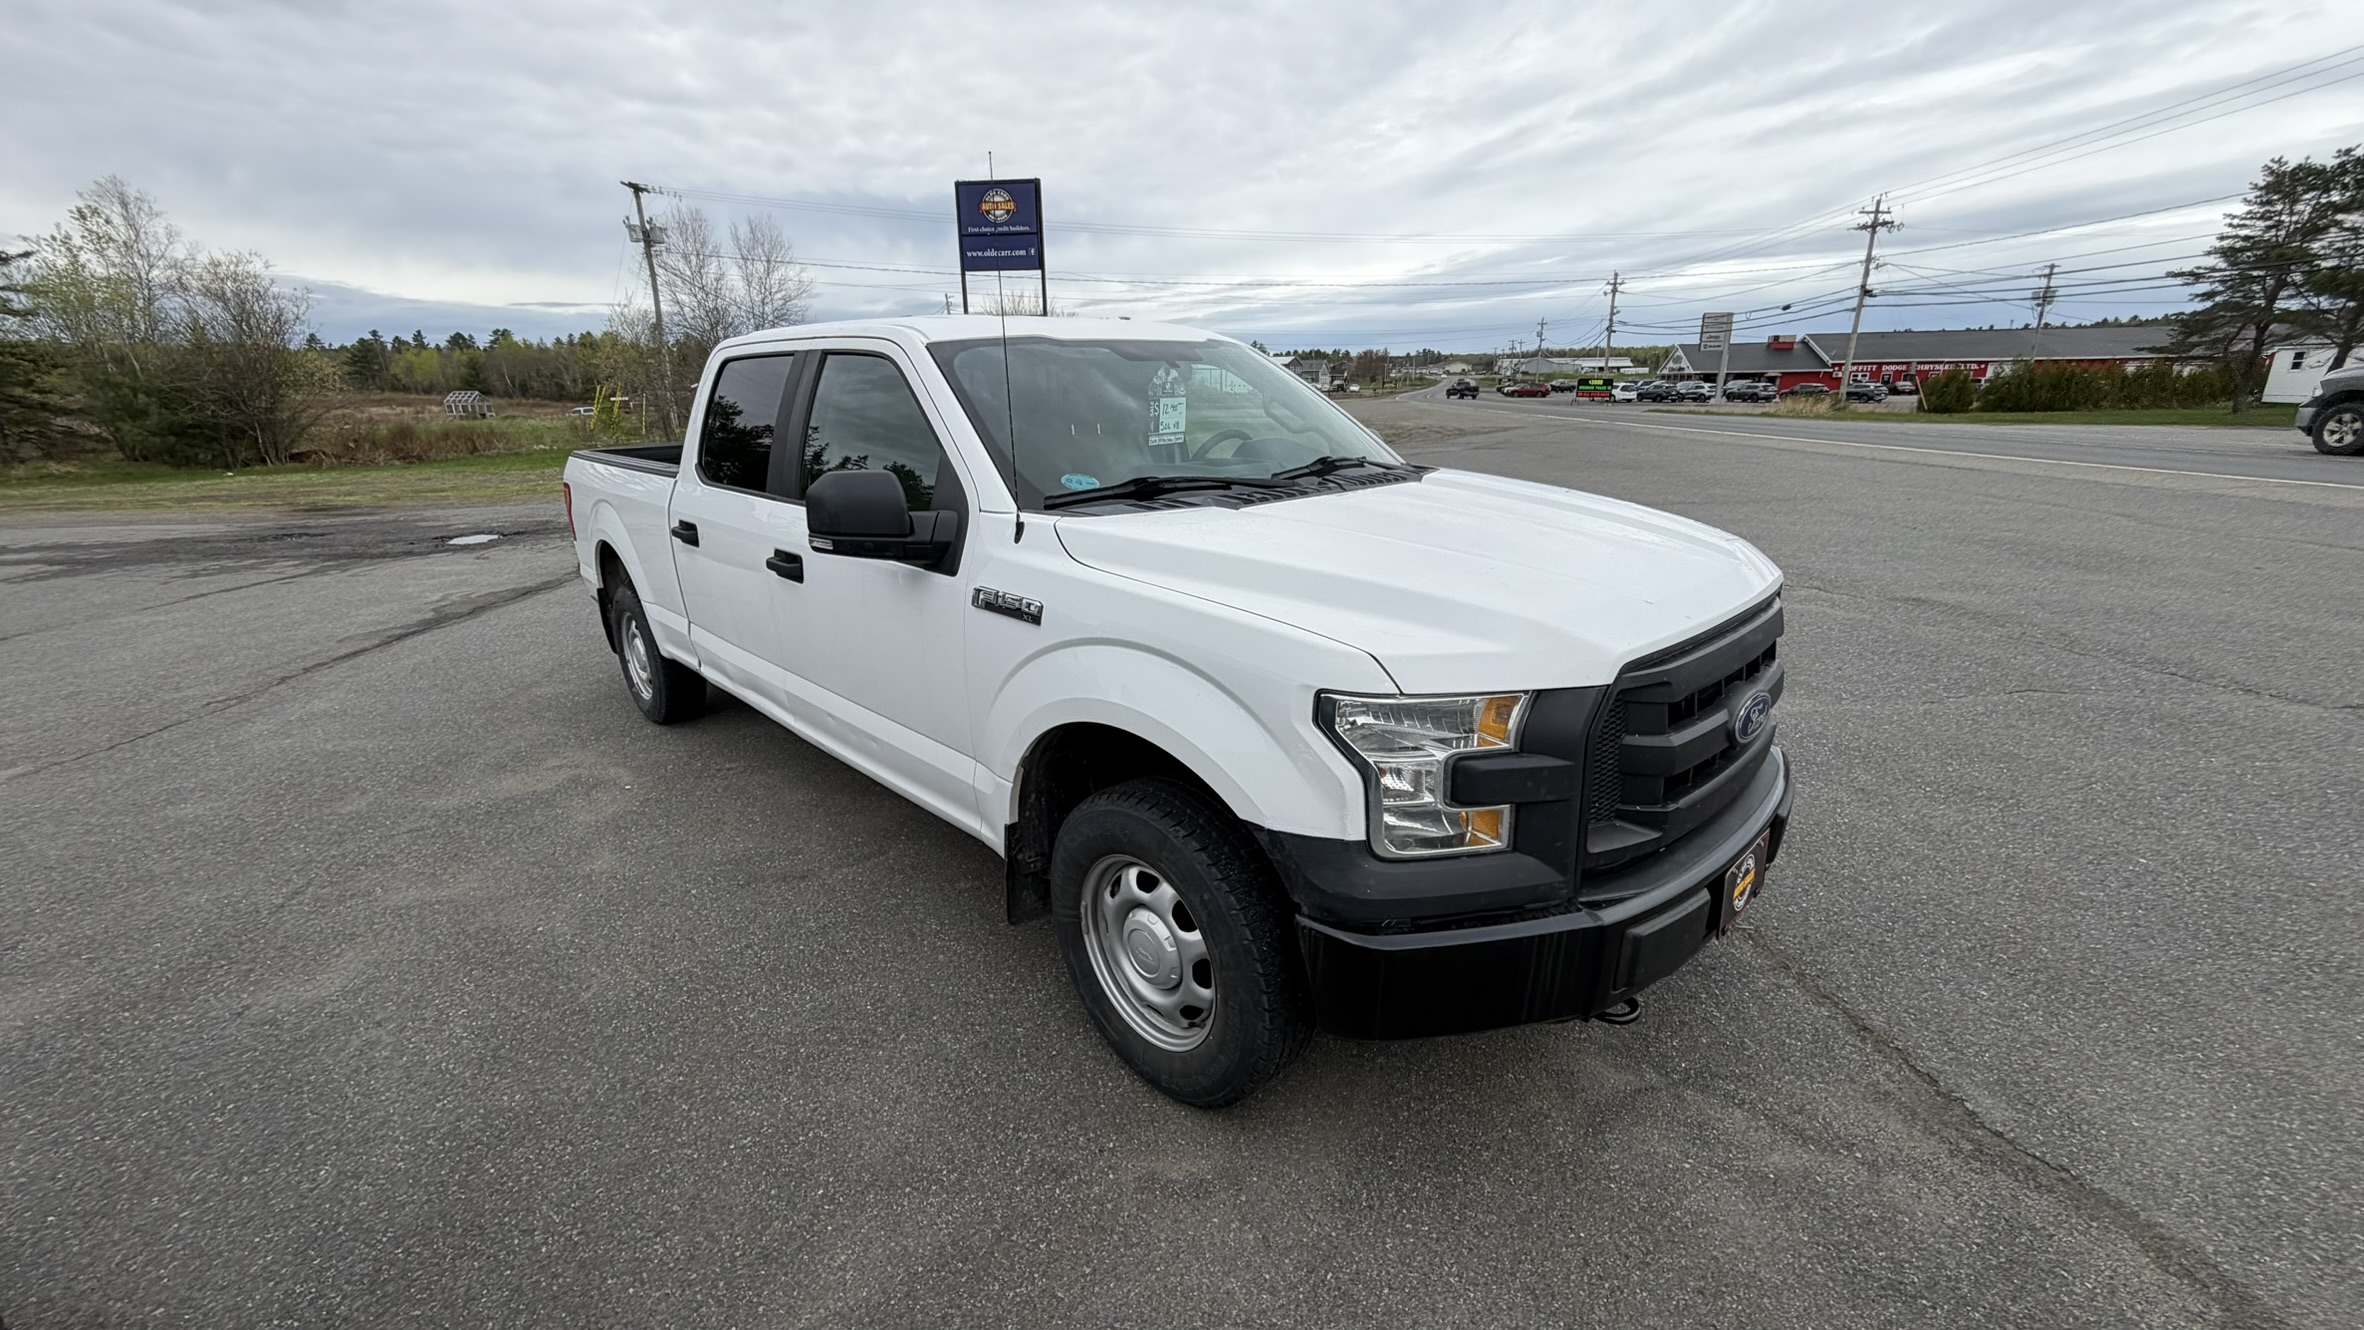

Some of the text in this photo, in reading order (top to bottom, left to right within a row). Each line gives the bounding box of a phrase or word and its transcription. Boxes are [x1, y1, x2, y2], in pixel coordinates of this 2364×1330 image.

[982, 202, 1015, 210] AUTO SALES
[966, 248, 1027, 257] www.oldecarr.com
[1022, 614, 1033, 622] XL
